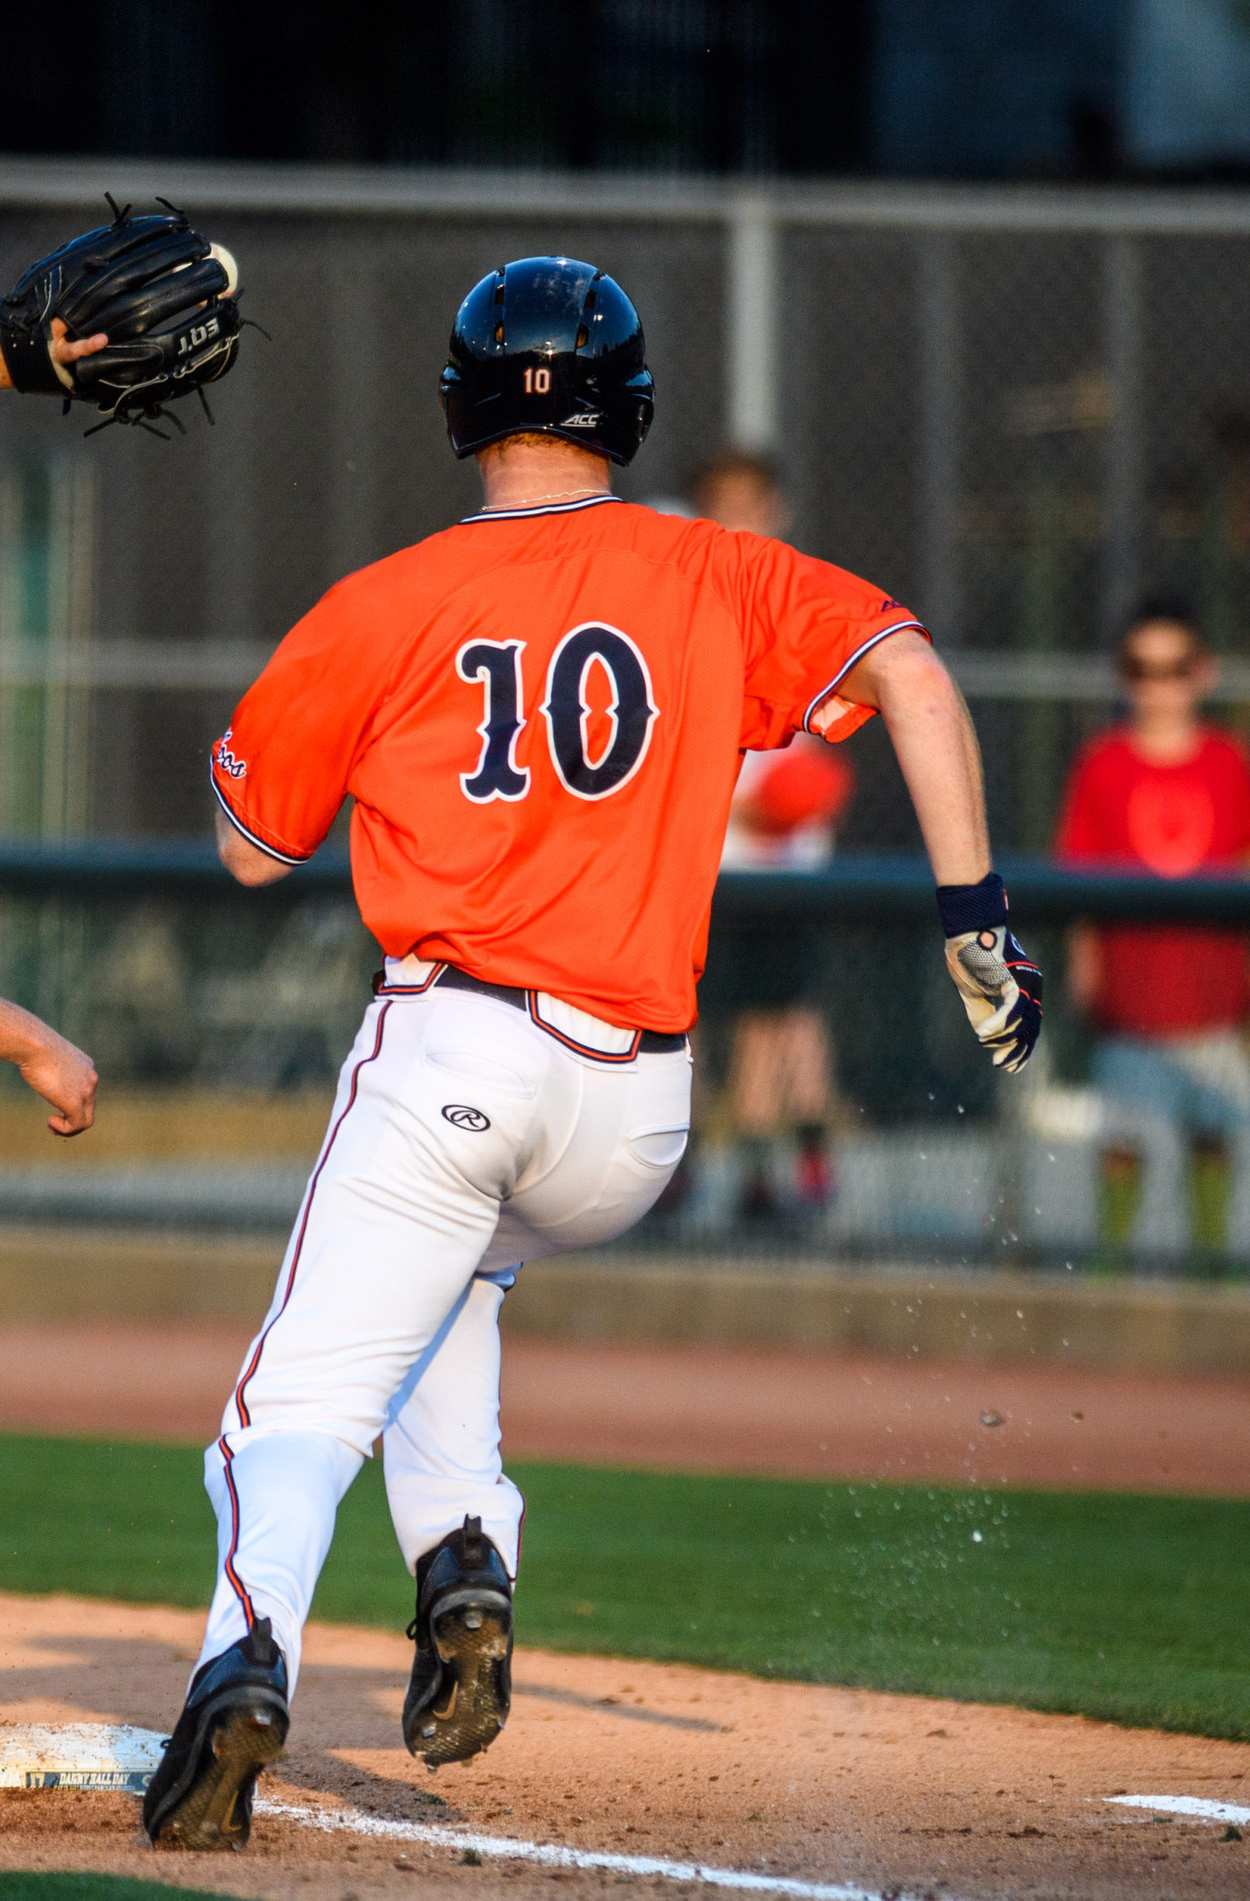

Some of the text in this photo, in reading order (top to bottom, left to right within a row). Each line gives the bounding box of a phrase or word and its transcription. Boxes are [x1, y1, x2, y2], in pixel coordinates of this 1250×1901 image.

[523, 368, 551, 394] 10
[563, 414, 599, 425] ACC
[455, 621, 661, 804] 10
[112, 1772, 131, 1785] DAY
